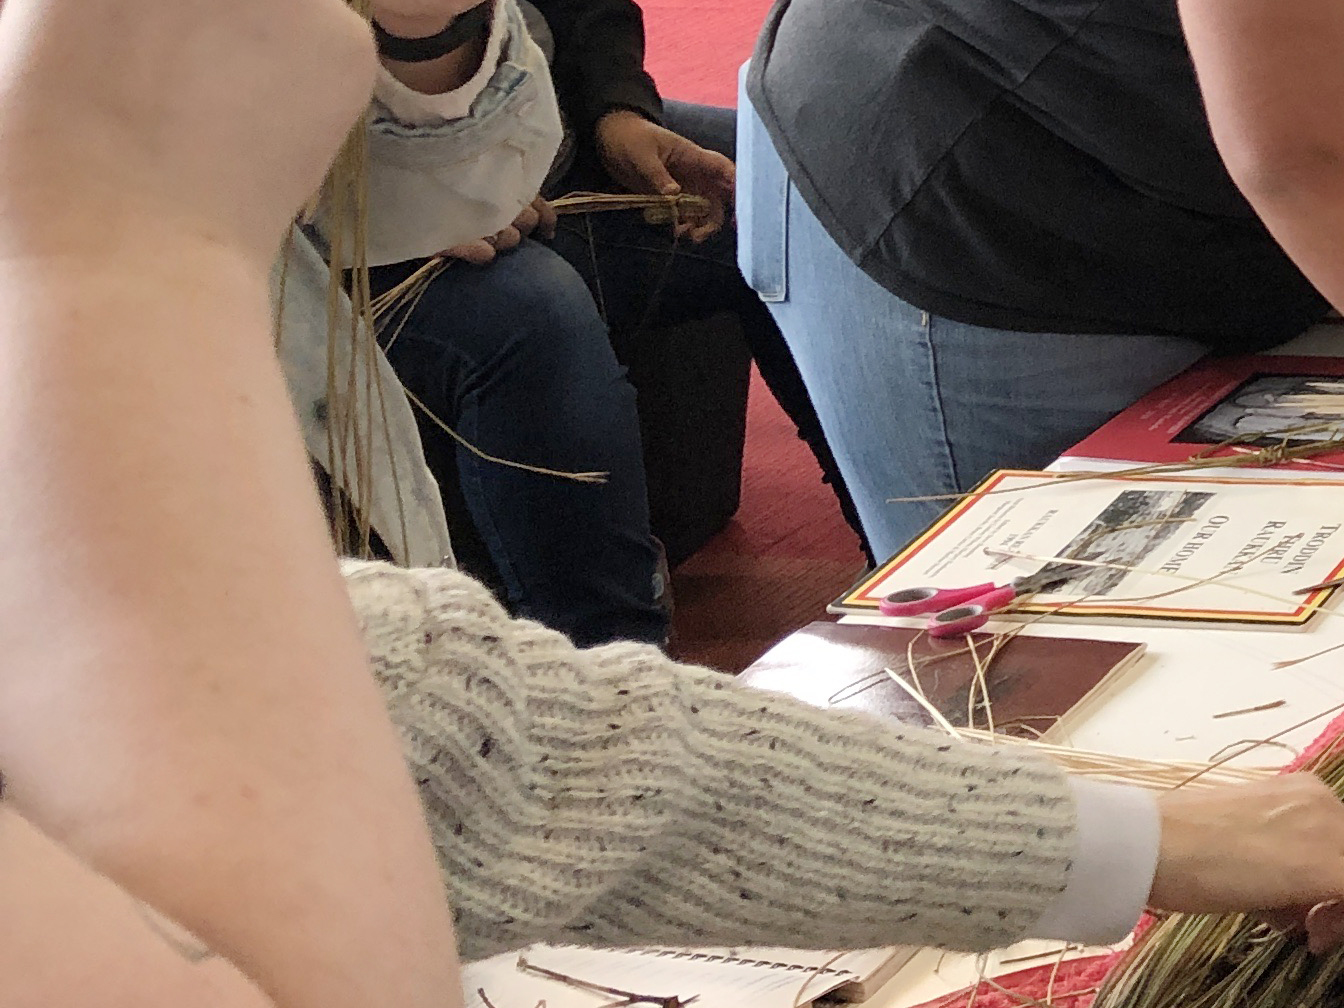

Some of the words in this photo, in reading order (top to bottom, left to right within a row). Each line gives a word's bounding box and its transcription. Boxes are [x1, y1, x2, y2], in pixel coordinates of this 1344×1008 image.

[1193, 515, 1230, 540] OUR
[1156, 542, 1204, 574] HOME
[1281, 523, 1341, 574] TRODDIN
